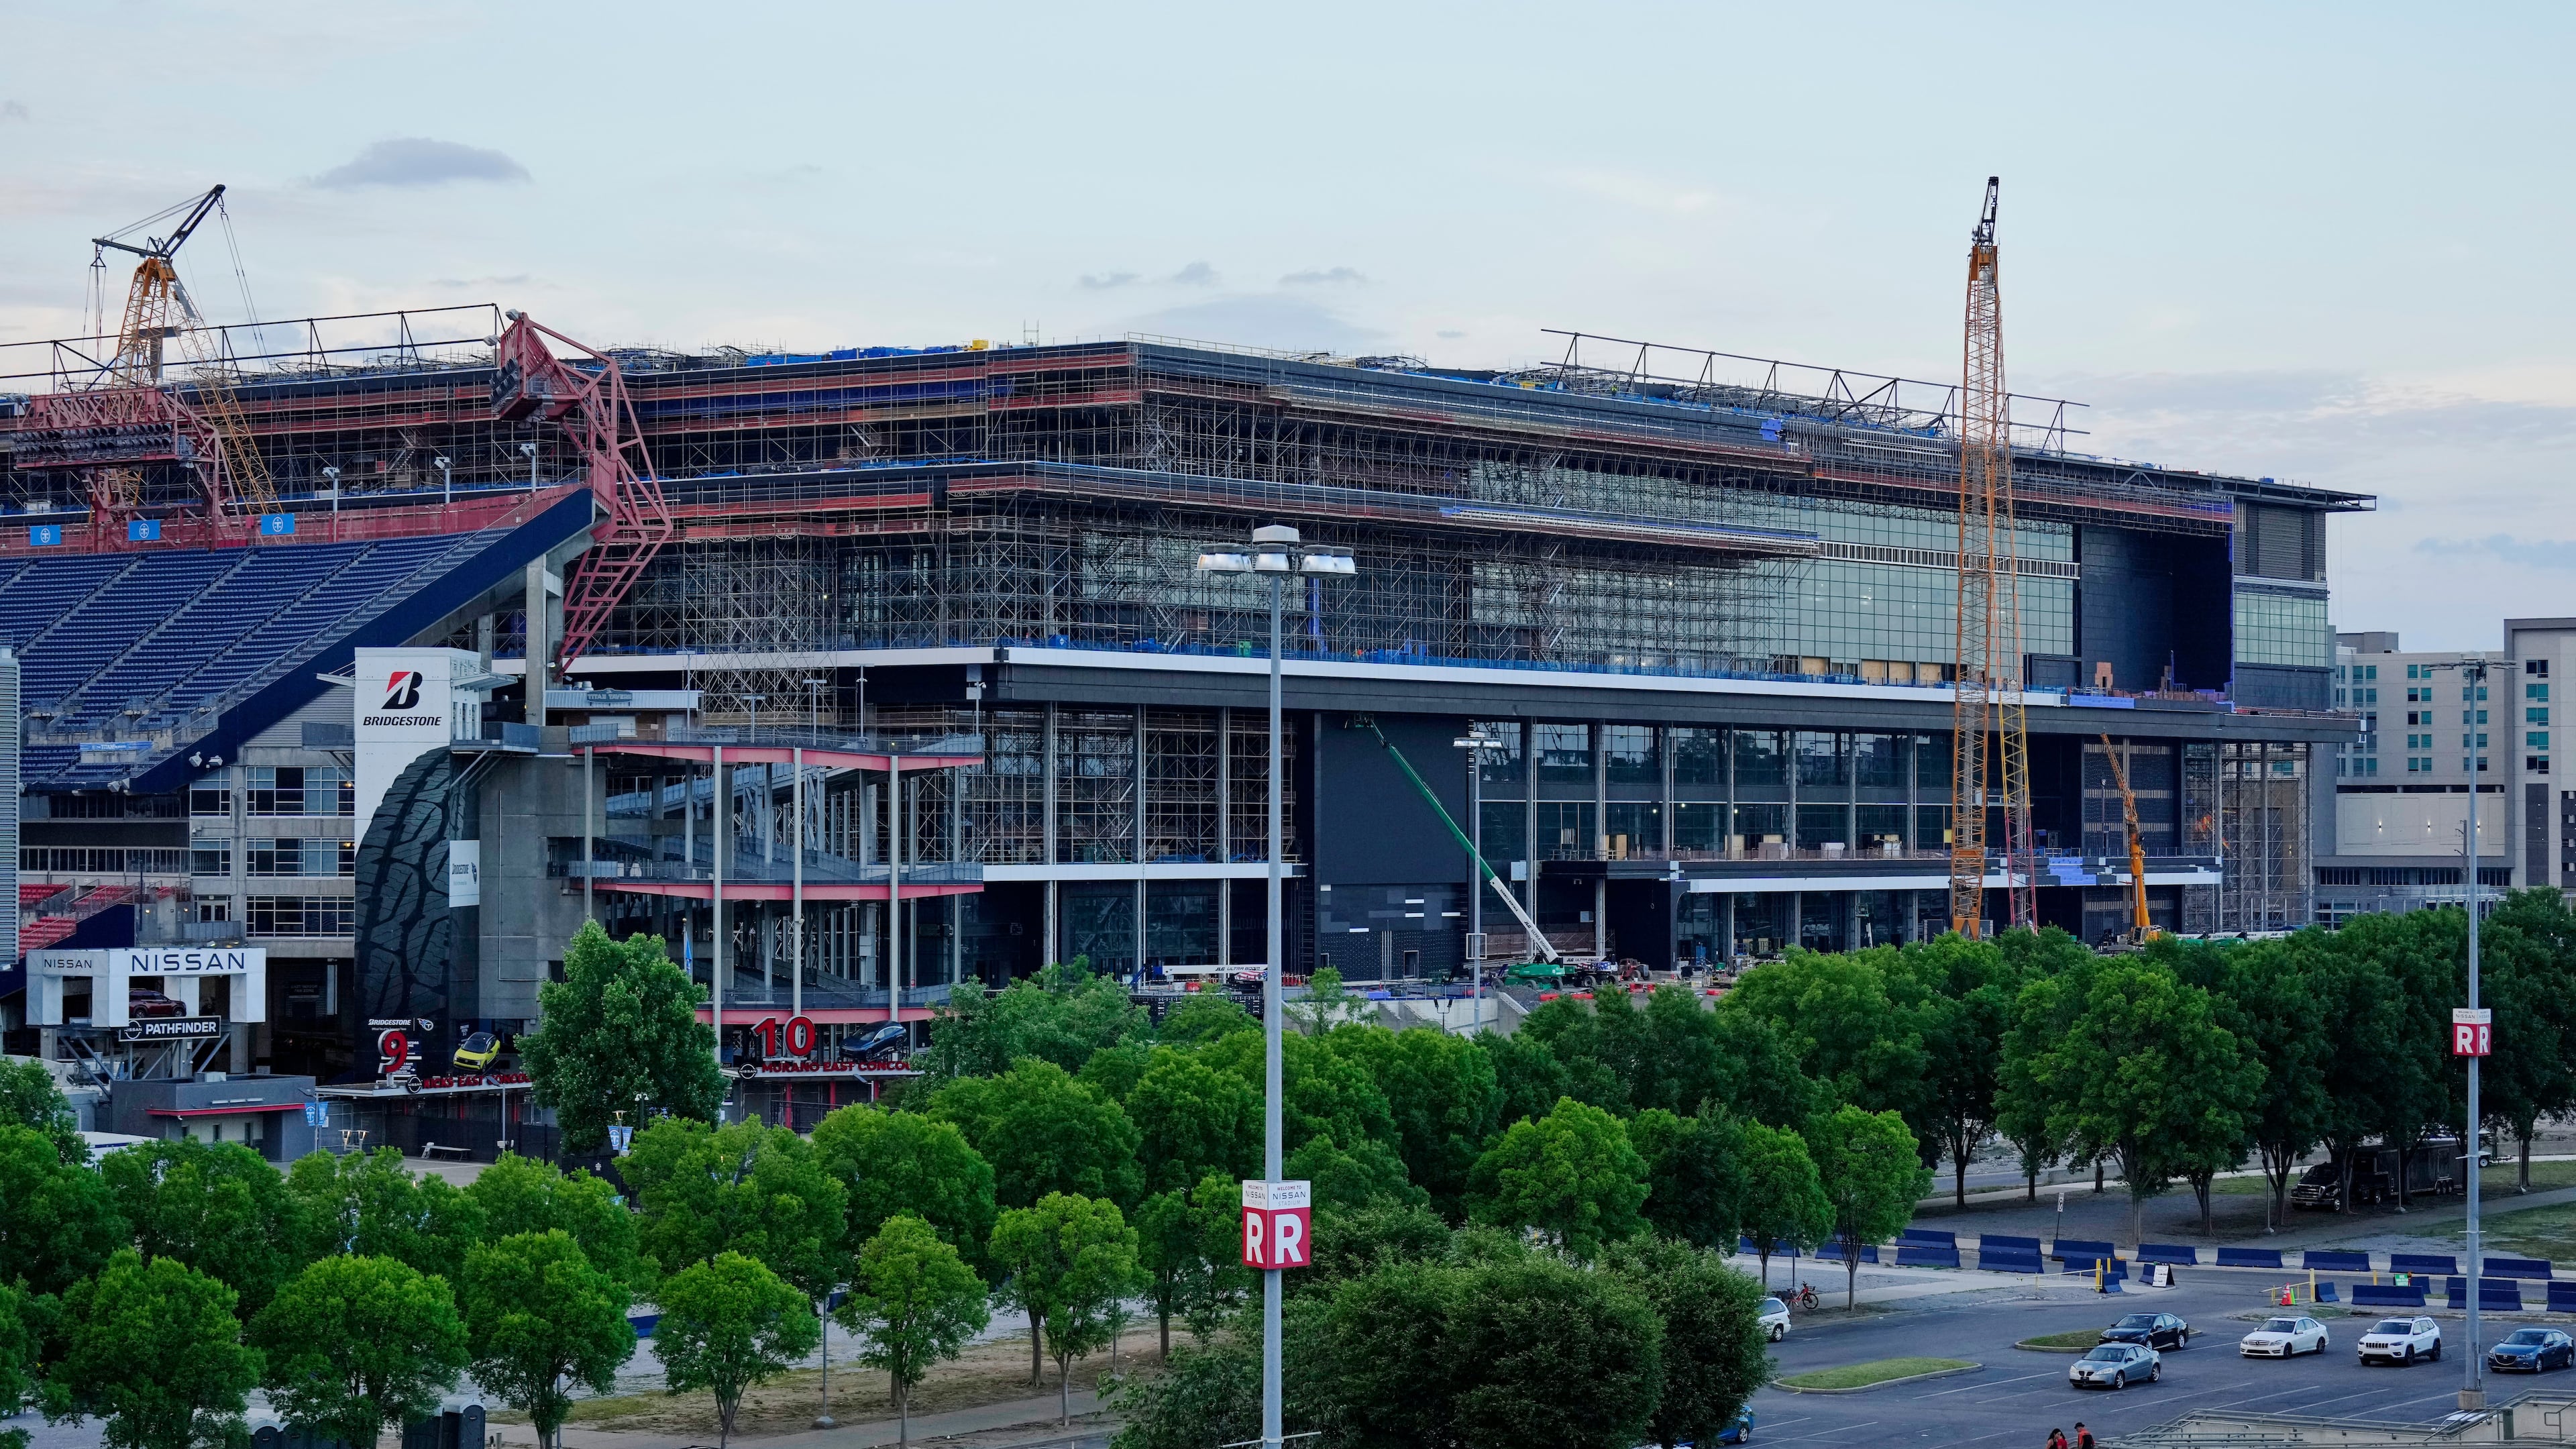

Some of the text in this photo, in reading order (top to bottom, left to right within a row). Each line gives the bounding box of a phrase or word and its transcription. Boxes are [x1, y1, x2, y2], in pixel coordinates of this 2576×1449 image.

[363, 716, 442, 725] BRIDGESTONE
[1531, 929, 1541, 941] ULTRA
[1540, 941, 1549, 951] BOOM
[44, 959, 92, 969] NISSAN
[132, 953, 245, 971] NISSAN
[146, 1021, 217, 1035] PATHFINDER
[751, 1015, 816, 1057] 10
[2457, 1025, 2473, 1054] R
[2479, 1026, 2489, 1053] R
[378, 1029, 407, 1073] 9
[762, 1062, 820, 1073] MURANO
[823, 1062, 856, 1072] EAST
[423, 1077, 454, 1089] KICKS
[458, 1075, 484, 1087] EAST
[1245, 1191, 1265, 1199] NISSAN
[1273, 1191, 1306, 1200] NISSAN
[1246, 1212, 1264, 1264] R
[1275, 1213, 1303, 1265] R
